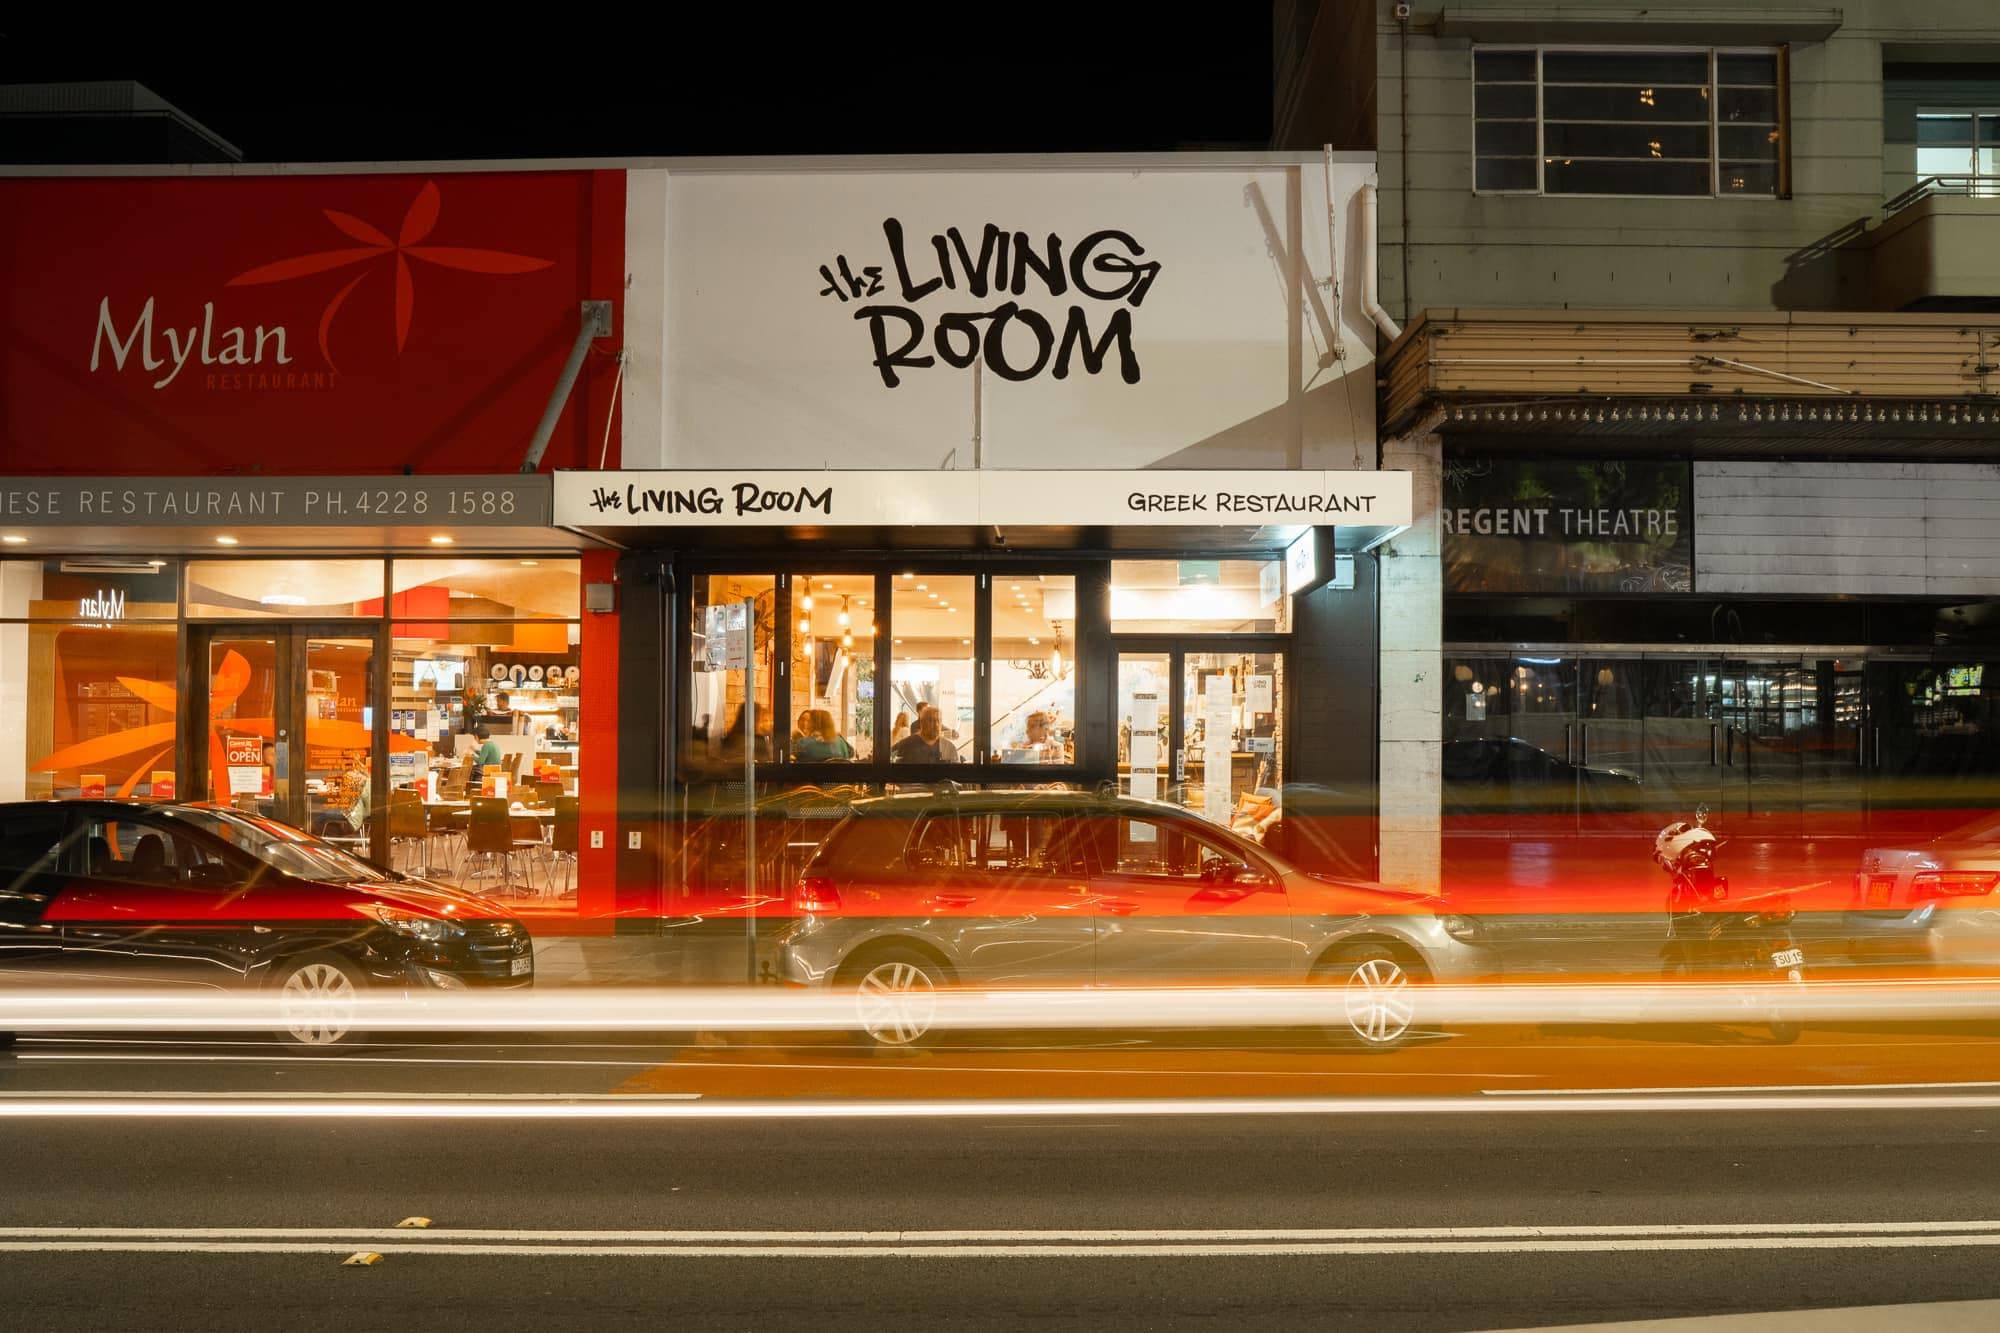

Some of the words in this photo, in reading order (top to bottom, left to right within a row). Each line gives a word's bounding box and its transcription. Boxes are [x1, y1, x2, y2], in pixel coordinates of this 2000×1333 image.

[820, 255, 885, 302] the
[883, 218, 1161, 307] LIVING
[91, 296, 292, 389] Mylan
[854, 301, 1140, 388] ROOM
[207, 373, 337, 390] RESTAURANT
[0, 491, 61, 514] ESE
[80, 491, 285, 514] RESTAURANT
[447, 491, 515, 514] 1588
[589, 487, 622, 513] the
[627, 484, 724, 515] LIVING
[732, 483, 832, 516] ROOM
[1127, 493, 1208, 512] GREEK
[1216, 493, 1377, 512] RESTAURANT
[1441, 508, 1549, 534] REGENT
[1559, 508, 1678, 535] THEATRE
[229, 751, 261, 763] OPEN
